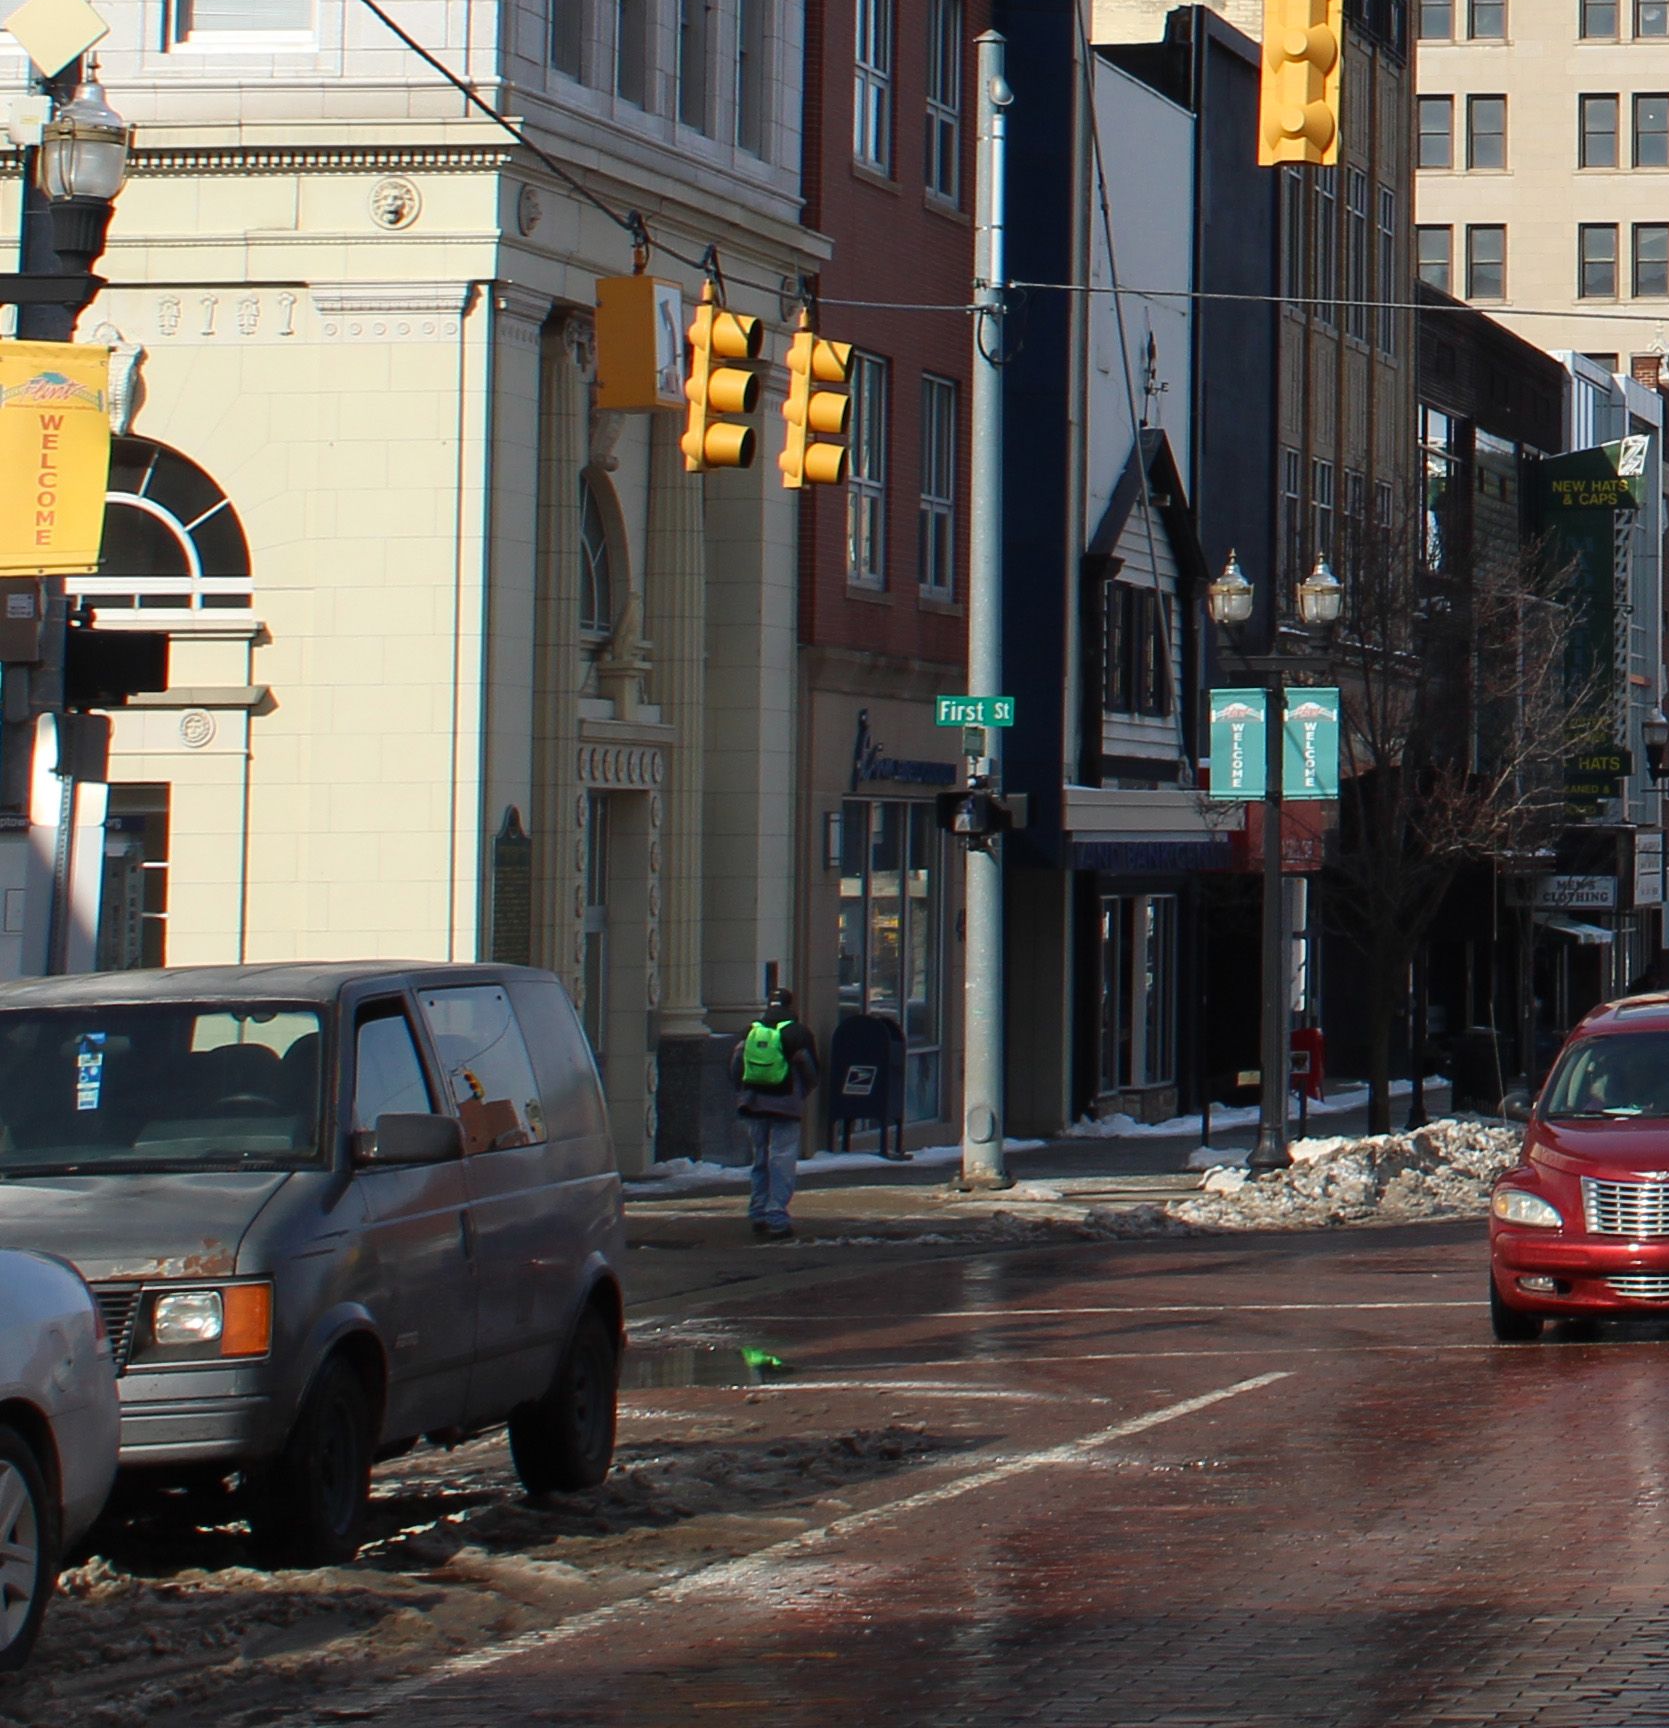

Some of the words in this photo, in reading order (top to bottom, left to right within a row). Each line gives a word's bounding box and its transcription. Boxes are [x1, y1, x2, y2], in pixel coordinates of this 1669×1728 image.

[36, 414, 64, 546] WELCOME
[1552, 480, 1585, 492] NEW
[1592, 479, 1629, 492] HATS
[1563, 493, 1572, 505] &
[1579, 493, 1617, 505] CAPS
[940, 701, 984, 721] First
[994, 702, 1010, 720] St
[1232, 722, 1245, 788] WELCOME
[1304, 722, 1317, 787] WELCOME
[1579, 757, 1620, 770] HATS
[1543, 891, 1609, 902] CLOTHING
